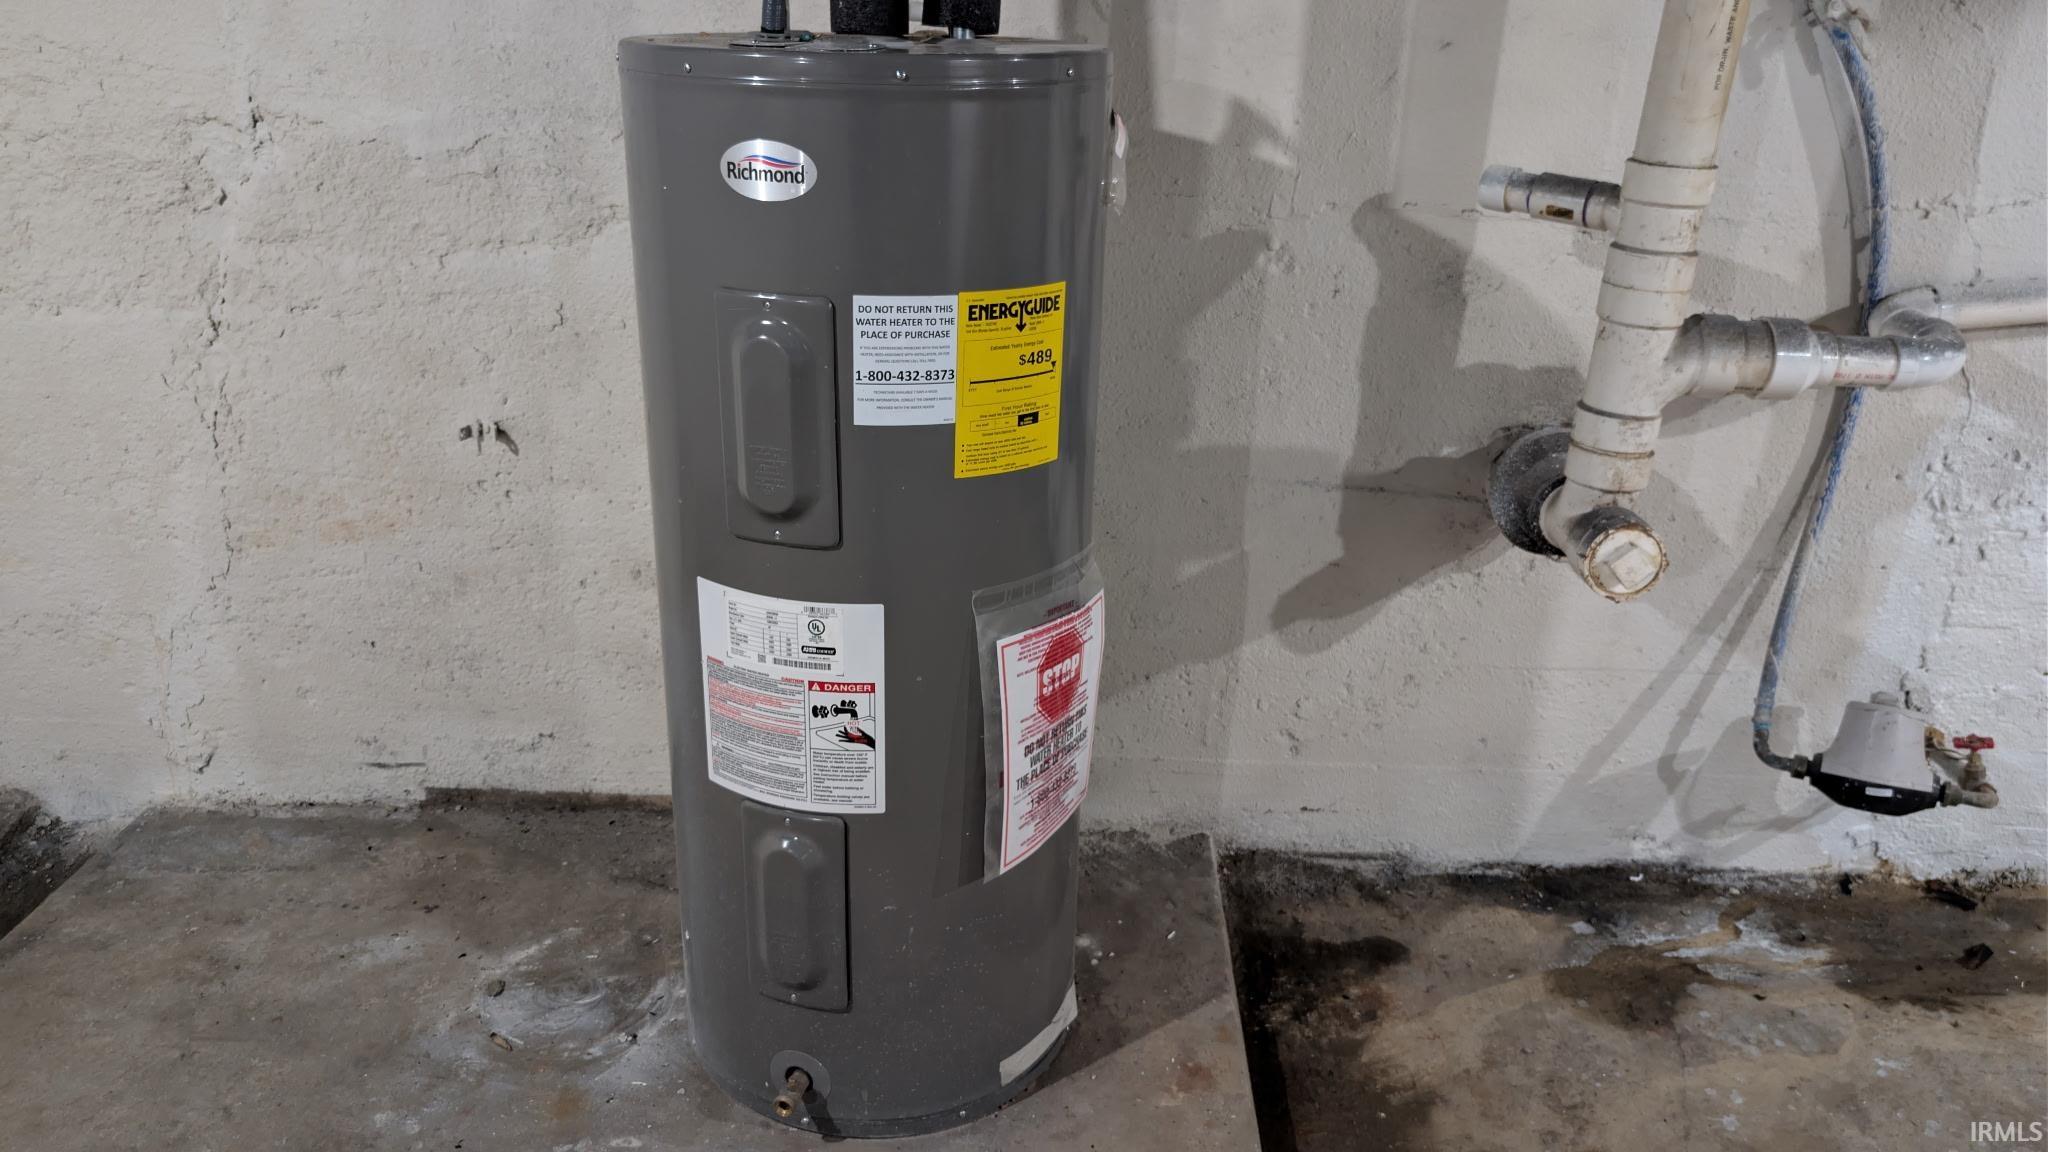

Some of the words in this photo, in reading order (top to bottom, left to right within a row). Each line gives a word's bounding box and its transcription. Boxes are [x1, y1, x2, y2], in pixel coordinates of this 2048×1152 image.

[727, 161, 805, 184] Richmond
[858, 305, 872, 314] DO
[874, 305, 894, 314] NOT
[896, 305, 932, 314] RETURN
[934, 304, 954, 313] THIS
[968, 295, 1060, 322] ENERGYGUIDE
[855, 317, 887, 326] WATER
[889, 318, 925, 327] HEATER
[925, 318, 937, 326] TO
[938, 317, 956, 326] THE
[860, 330, 888, 339] PLACE
[890, 331, 902, 339] OF
[904, 330, 951, 339] PURCHASE
[1019, 348, 1052, 366] $489
[855, 369, 955, 382] 1-800-432-8373
[1042, 654, 1080, 696] STOP
[824, 684, 872, 692] DANGER
